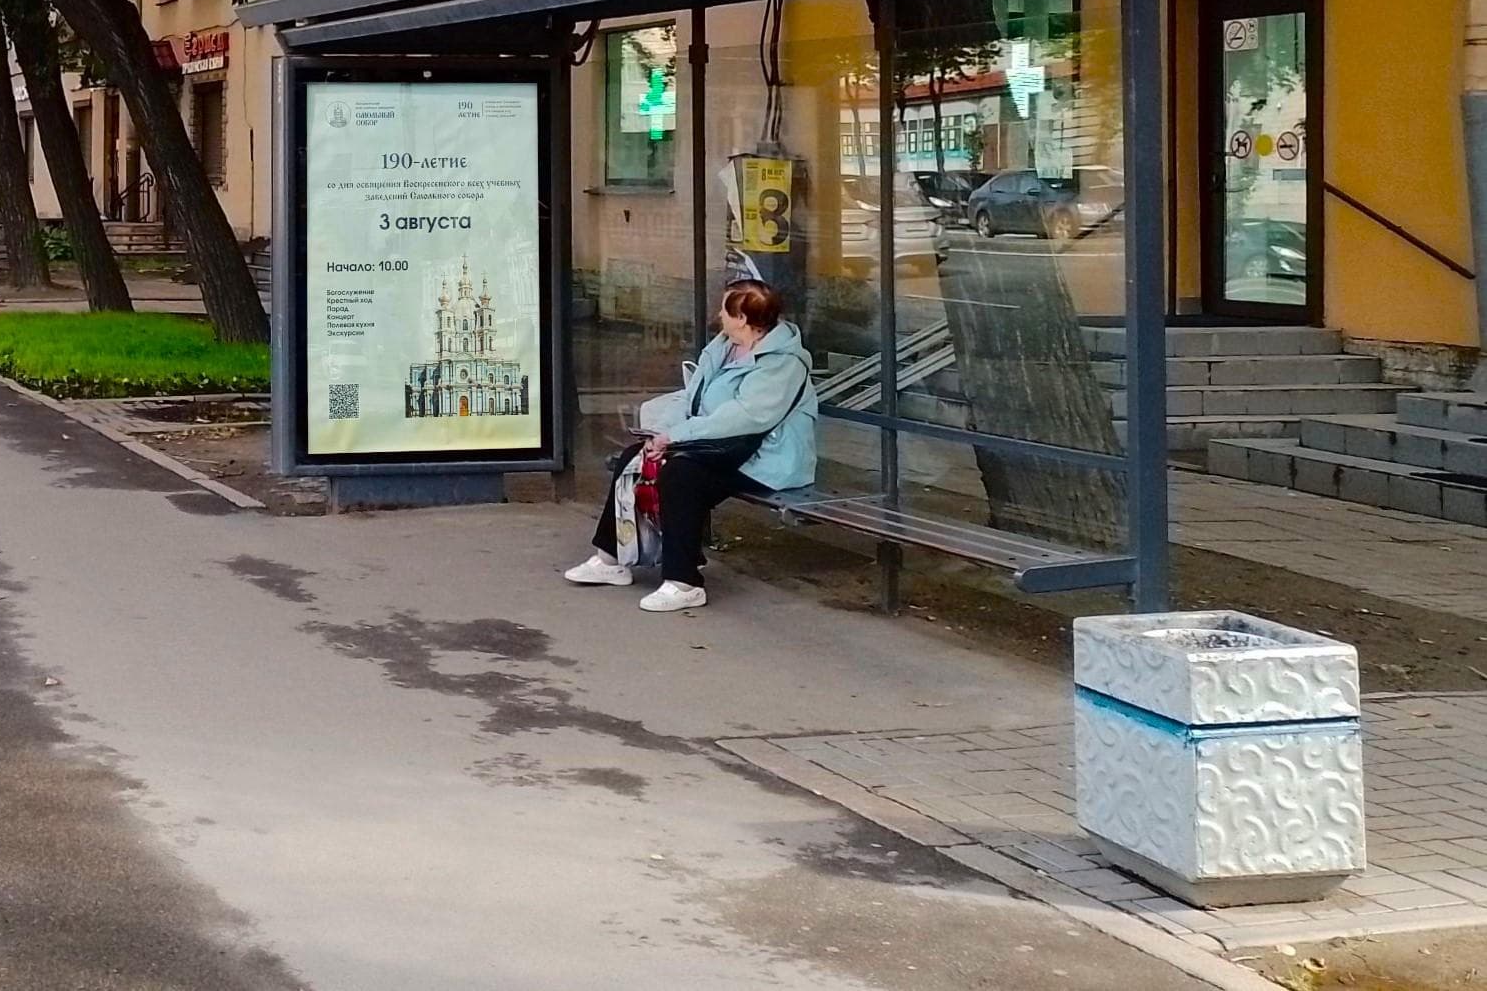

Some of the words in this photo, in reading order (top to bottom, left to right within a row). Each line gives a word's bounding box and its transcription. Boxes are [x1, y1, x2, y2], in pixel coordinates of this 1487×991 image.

[381, 152, 467, 169] 190-летие
[380, 213, 390, 230] 3
[395, 216, 471, 233] августа
[327, 262, 375, 272] Начало:
[379, 260, 409, 271] 10.00
